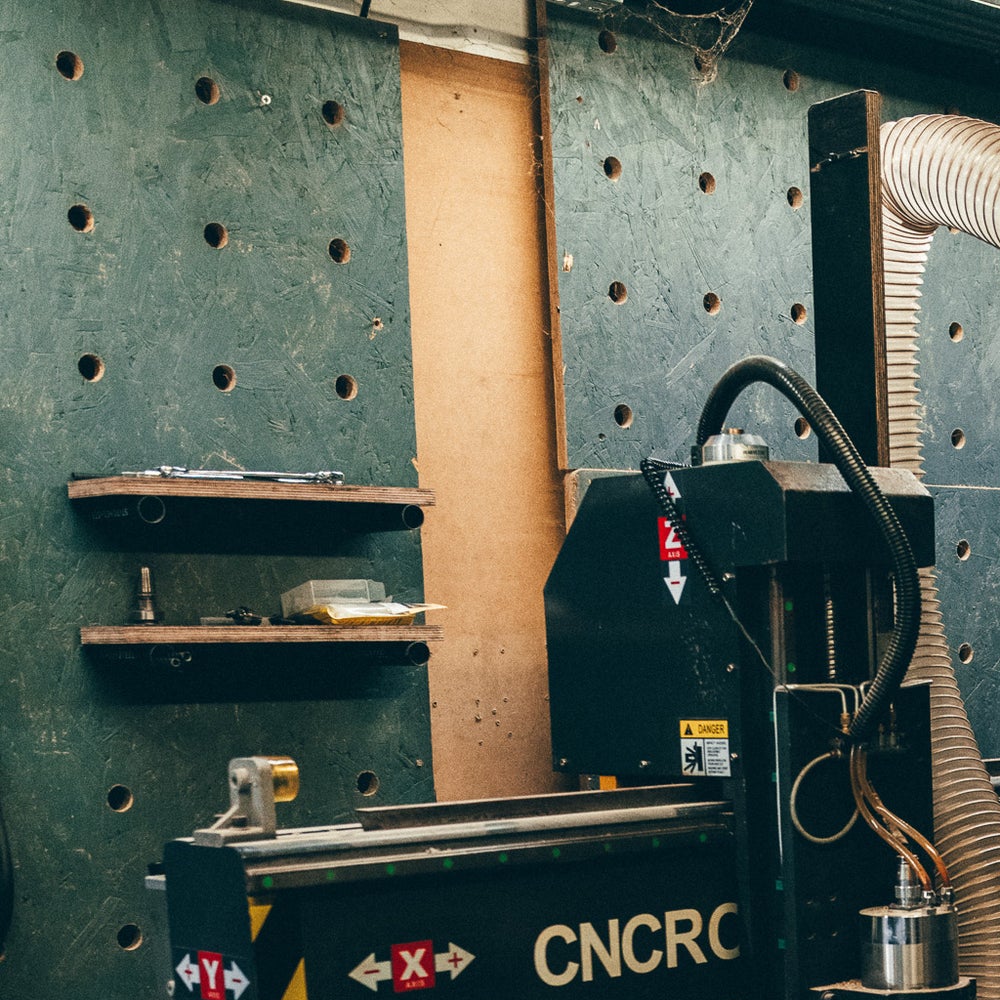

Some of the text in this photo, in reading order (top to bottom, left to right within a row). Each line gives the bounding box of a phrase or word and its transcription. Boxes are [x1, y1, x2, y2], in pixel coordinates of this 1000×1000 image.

[664, 520, 682, 549] Z
[698, 724, 725, 735] DANGER
[202, 958, 220, 990] Y
[399, 948, 429, 981] X
